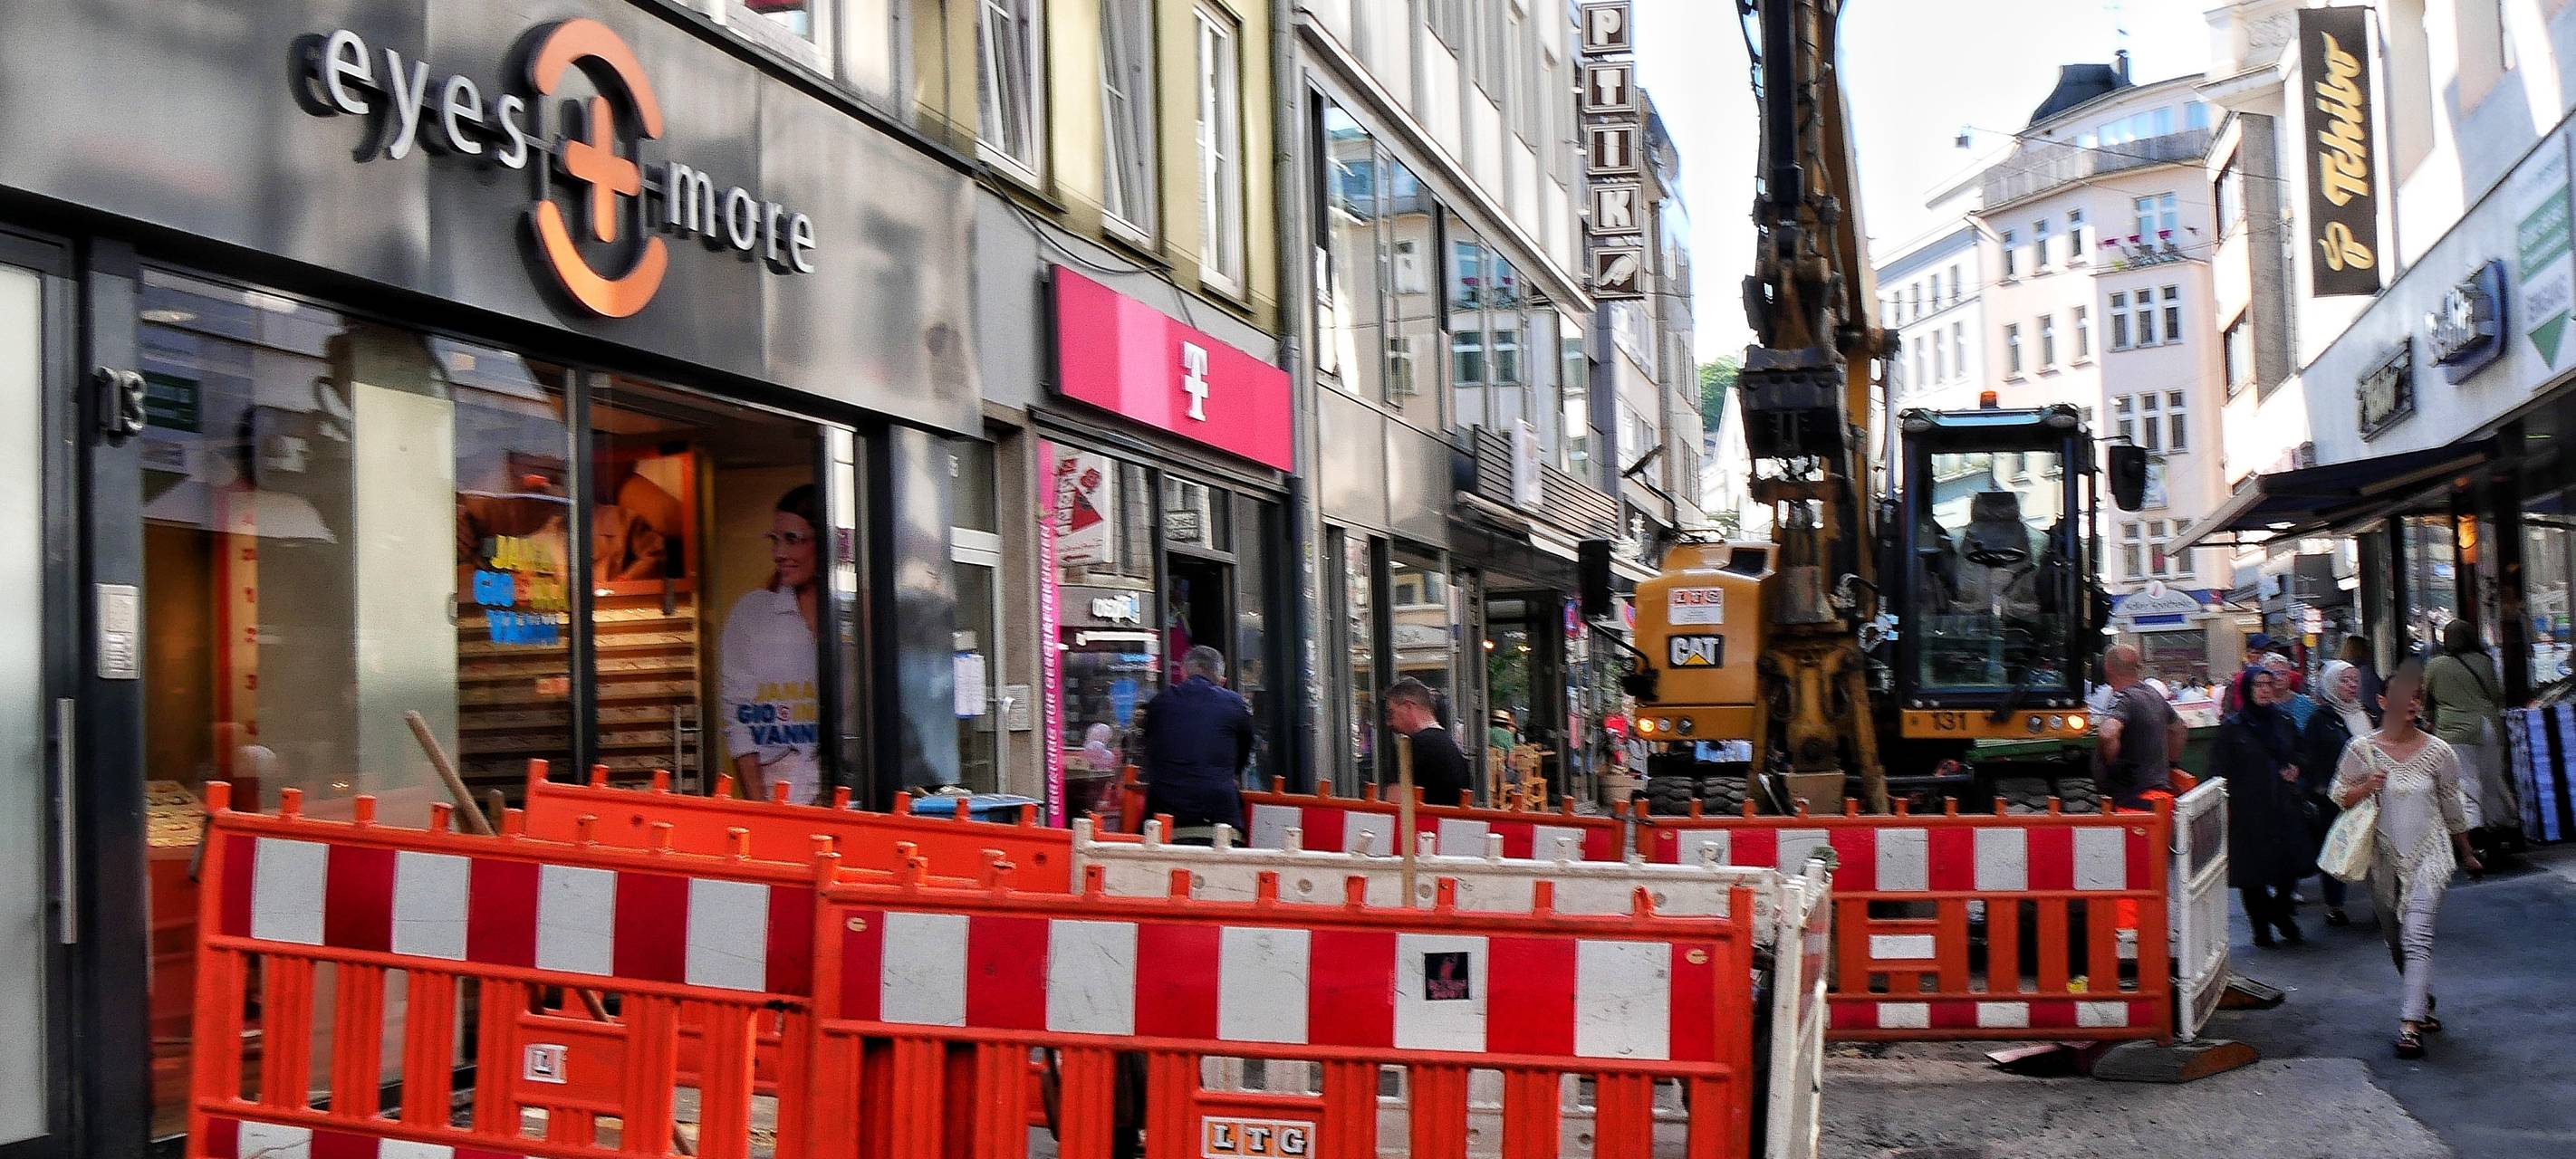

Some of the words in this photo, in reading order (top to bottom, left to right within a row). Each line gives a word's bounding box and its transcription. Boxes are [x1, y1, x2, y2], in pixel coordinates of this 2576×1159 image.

[2315, 30, 2369, 208] Tchibo
[320, 28, 528, 170] eyes
[668, 160, 816, 273] more
[98, 366, 148, 431] 13
[1670, 637, 1719, 666] CAT
[1932, 712, 1966, 731] 131
[1214, 1125, 1307, 1154] LTG
